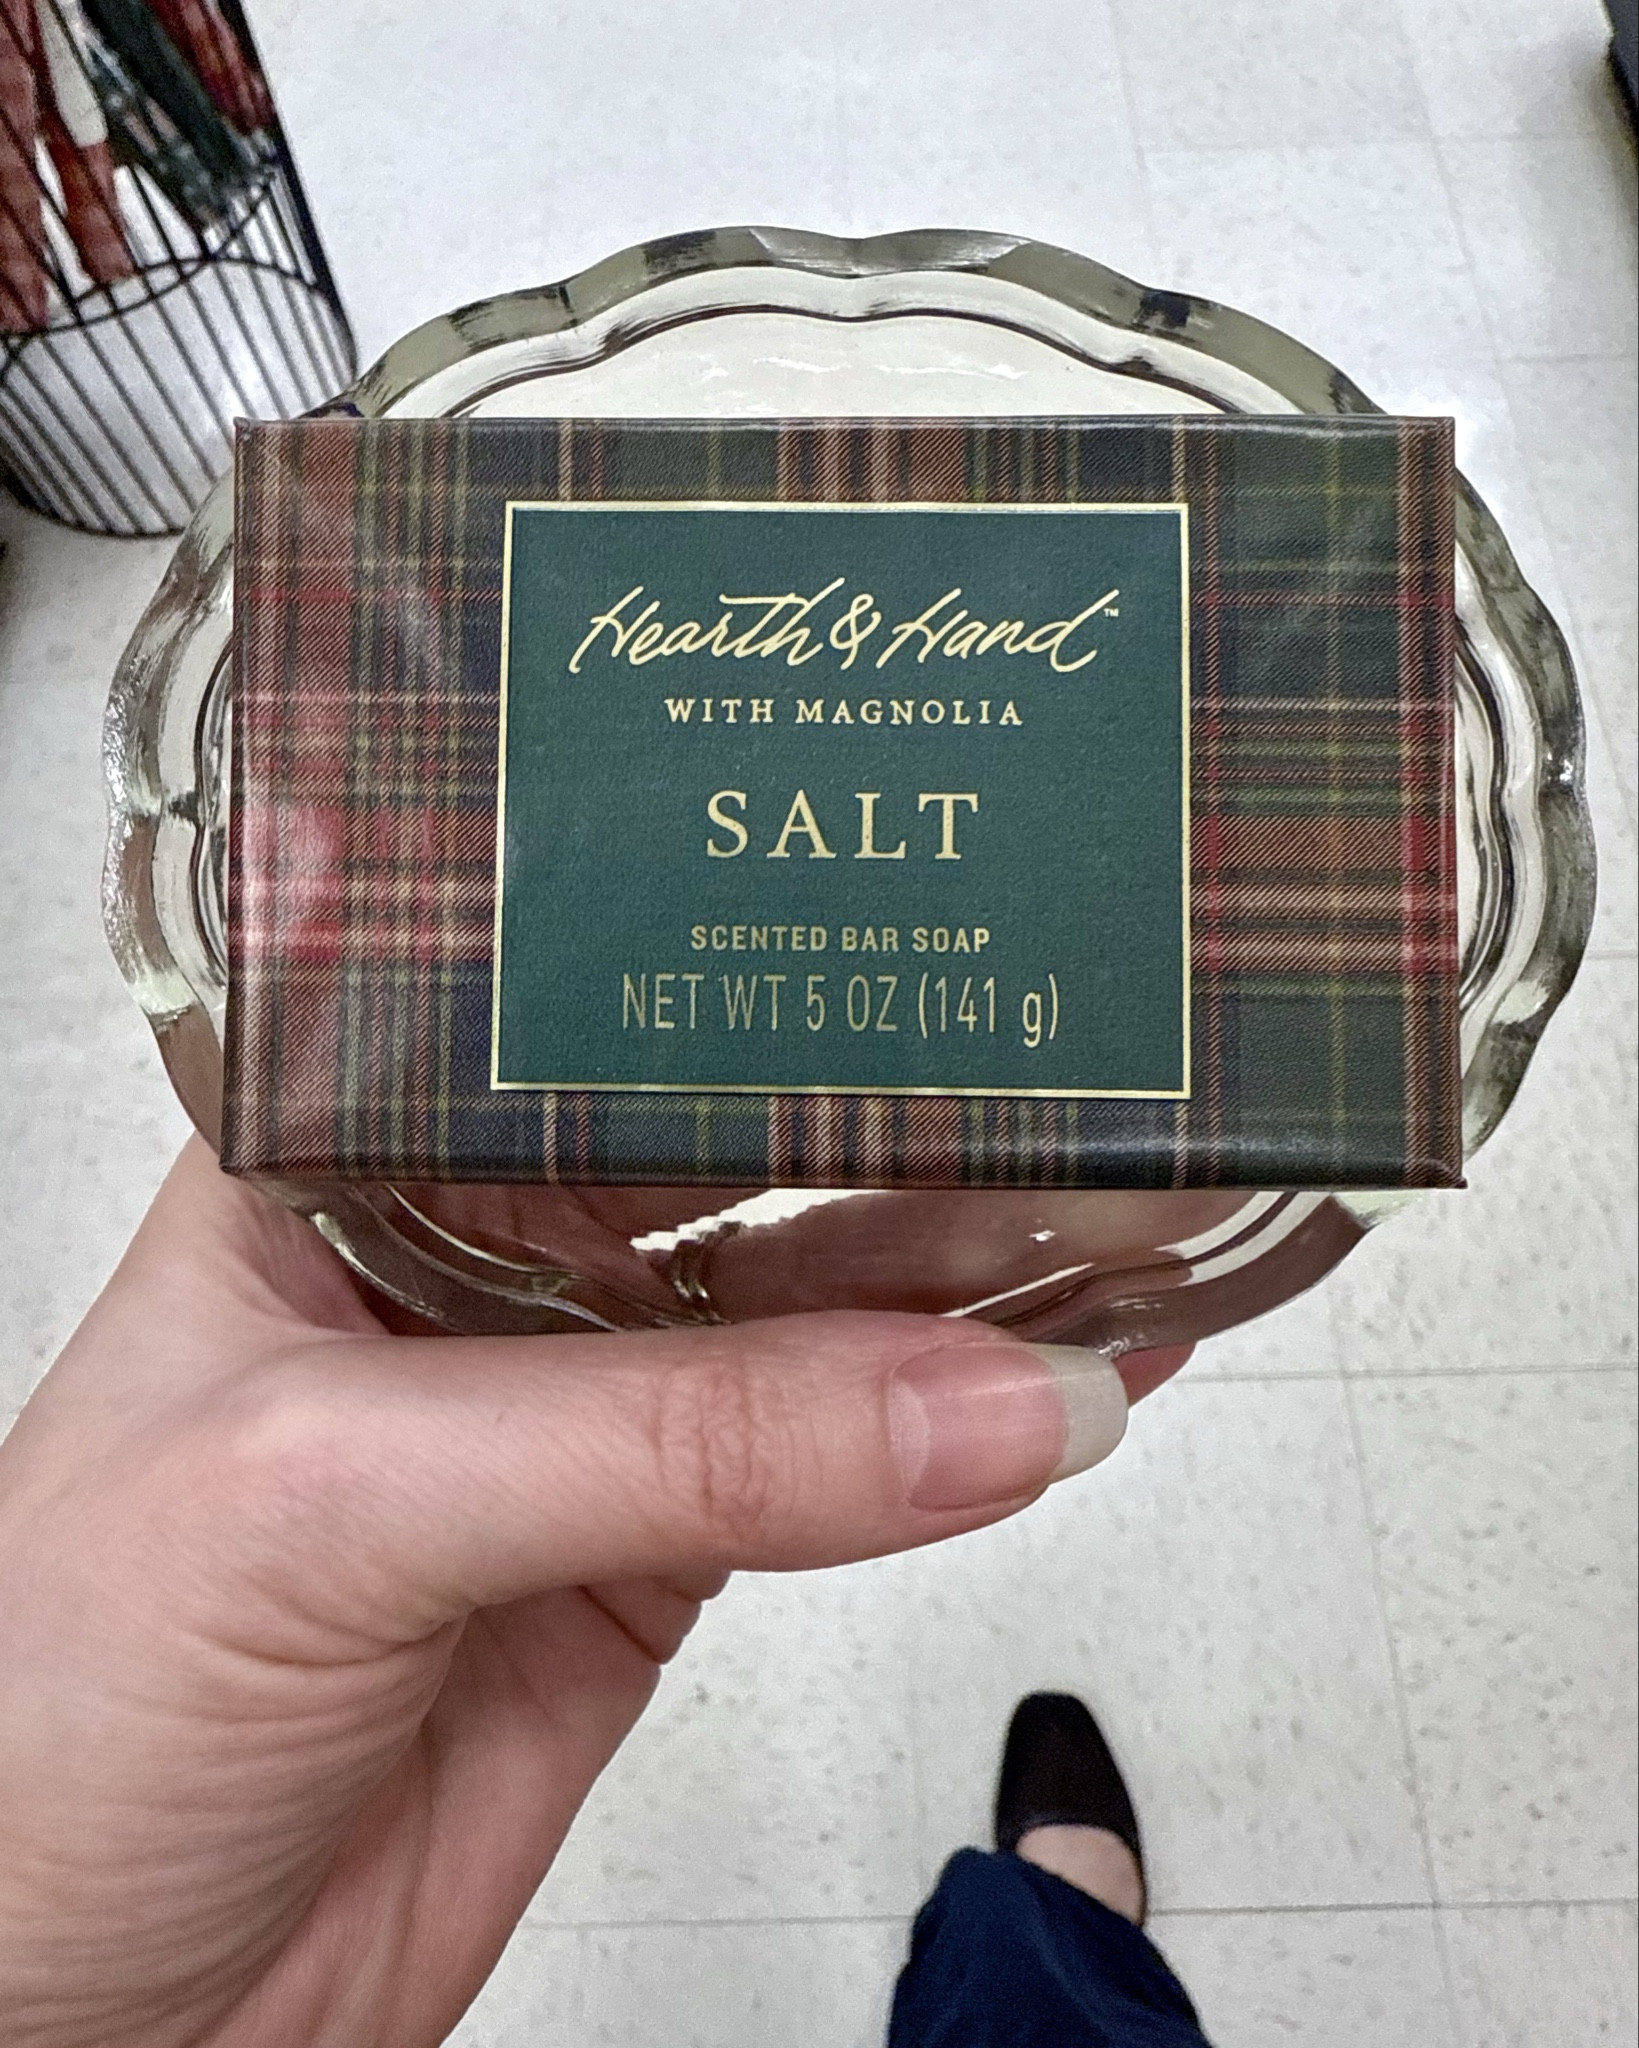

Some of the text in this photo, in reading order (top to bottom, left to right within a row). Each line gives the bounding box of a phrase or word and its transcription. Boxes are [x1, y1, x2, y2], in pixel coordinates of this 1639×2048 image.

[568, 577, 846, 673] Hearth
[829, 593, 882, 670] &
[664, 699, 1023, 727] WITH MAGNOLIA
[706, 789, 979, 861] SALT
[690, 925, 991, 954] SCENTED BAR SOAP
[621, 972, 1060, 1049] NET WT 5 OZ (141 g)
